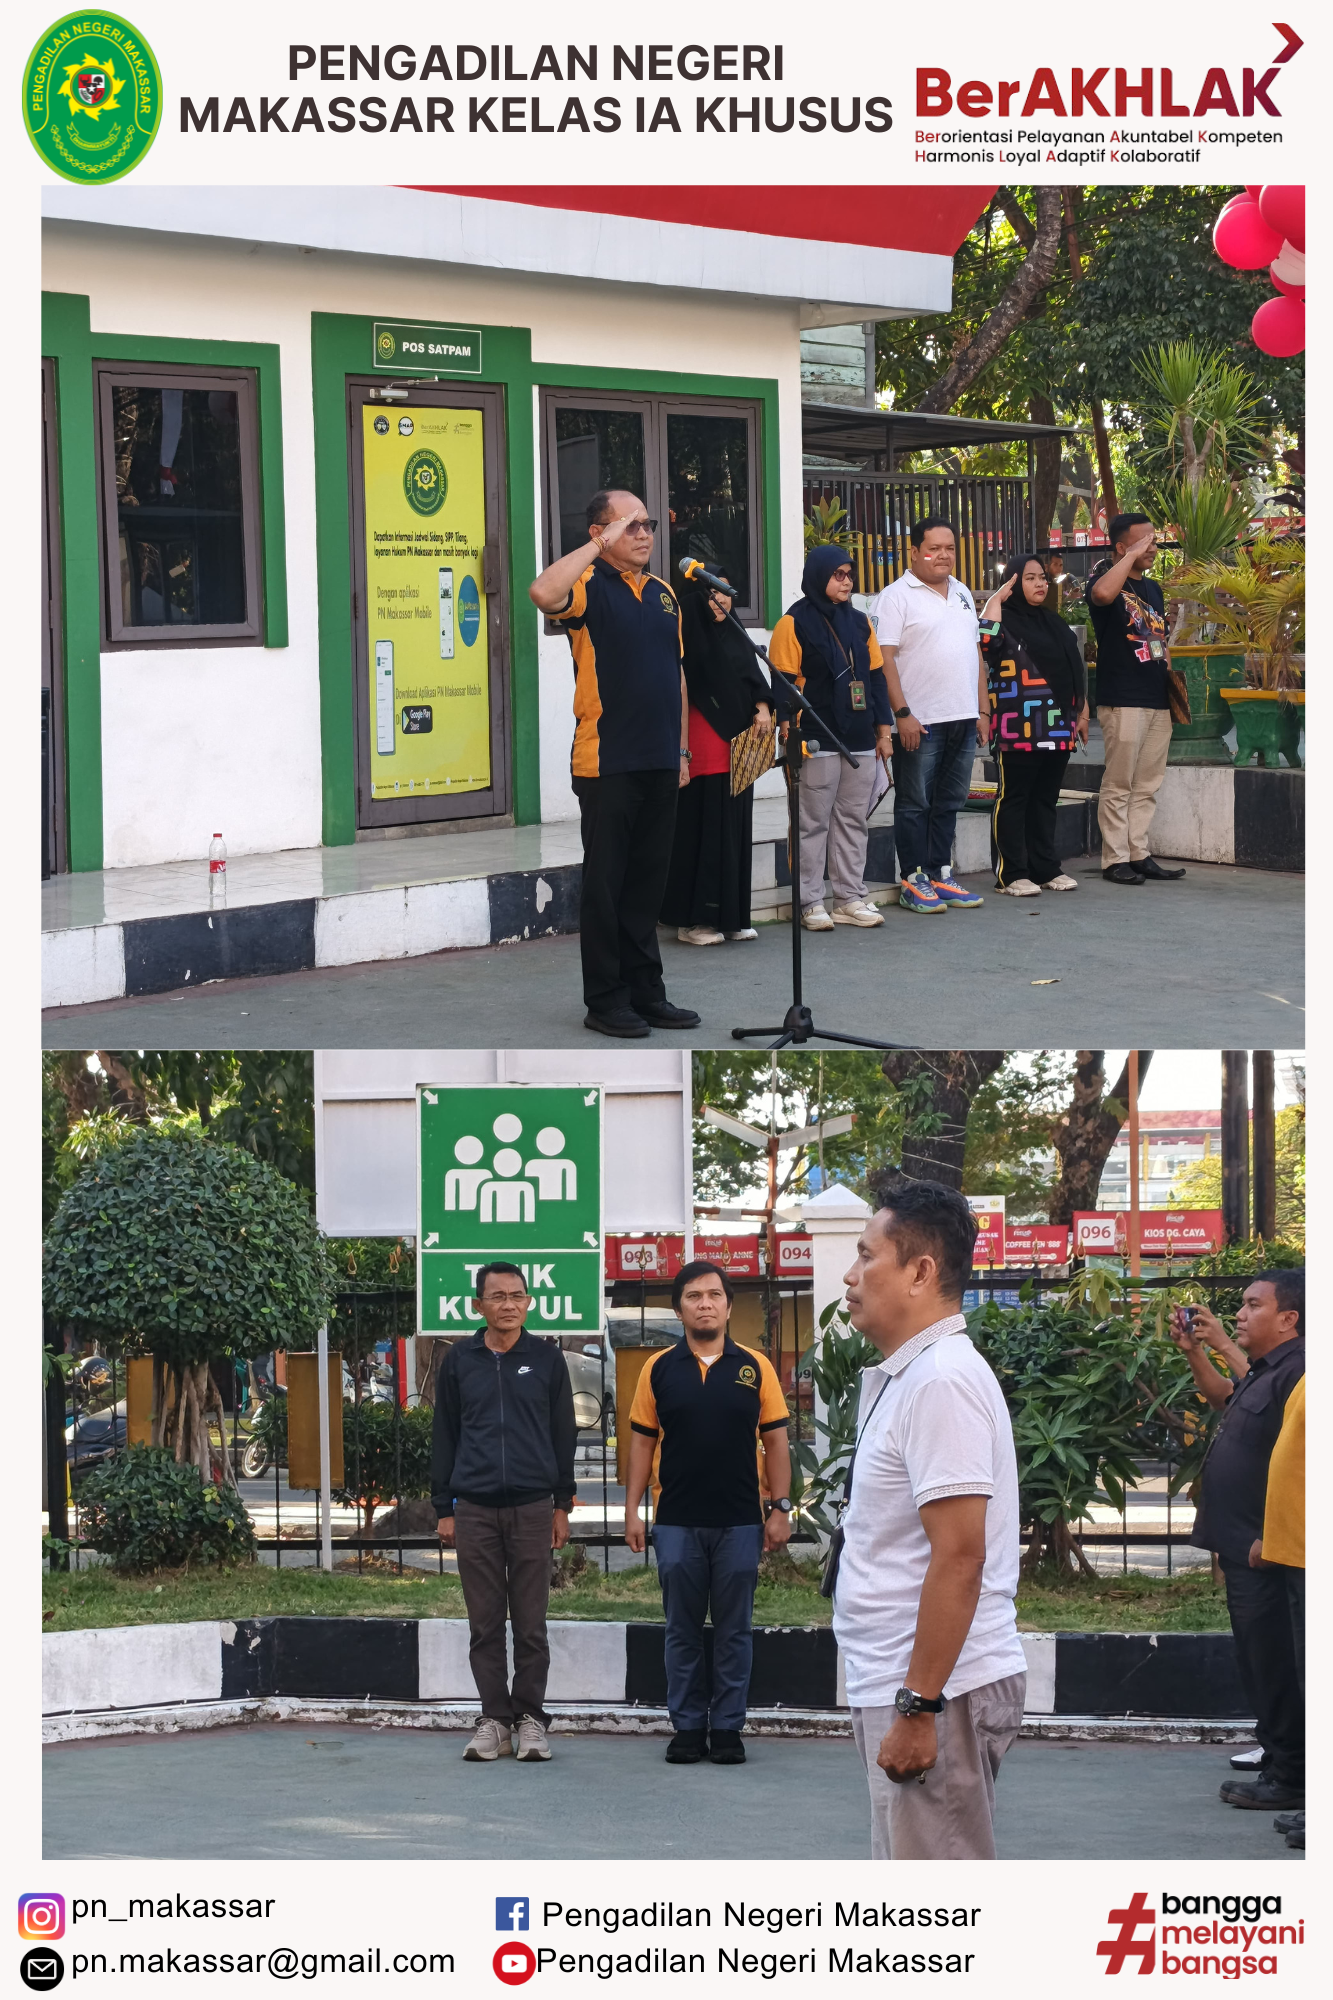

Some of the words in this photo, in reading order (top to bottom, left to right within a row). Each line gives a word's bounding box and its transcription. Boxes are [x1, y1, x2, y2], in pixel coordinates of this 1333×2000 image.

[402, 341, 425, 353] POS
[428, 343, 471, 357] SATPAM
[374, 530, 394, 545] Dapatkan
[392, 546, 407, 556] Hukum
[407, 546, 414, 555] PN
[414, 546, 433, 556] Makassar
[434, 546, 442, 556] dan
[455, 546, 470, 559] banyak
[377, 586, 398, 602] Dengan
[399, 585, 420, 602] aplikasi
[377, 607, 386, 619] PN
[387, 605, 414, 619] Makassar
[415, 604, 432, 619] Mobile
[395, 687, 418, 699] Download
[419, 686, 436, 701] Aplikasi
[437, 686, 444, 697] PN
[445, 684, 466, 697] Makassar
[1081, 1226, 1111, 1239] 096
[1144, 1229, 1164, 1238] KIOS
[1167, 1228, 1181, 1237] DG.
[1183, 1228, 1205, 1237] CAYA
[1005, 1241, 1031, 1249] COFFEE
[782, 1247, 812, 1260] 094
[464, 1264, 556, 1288] TIK
